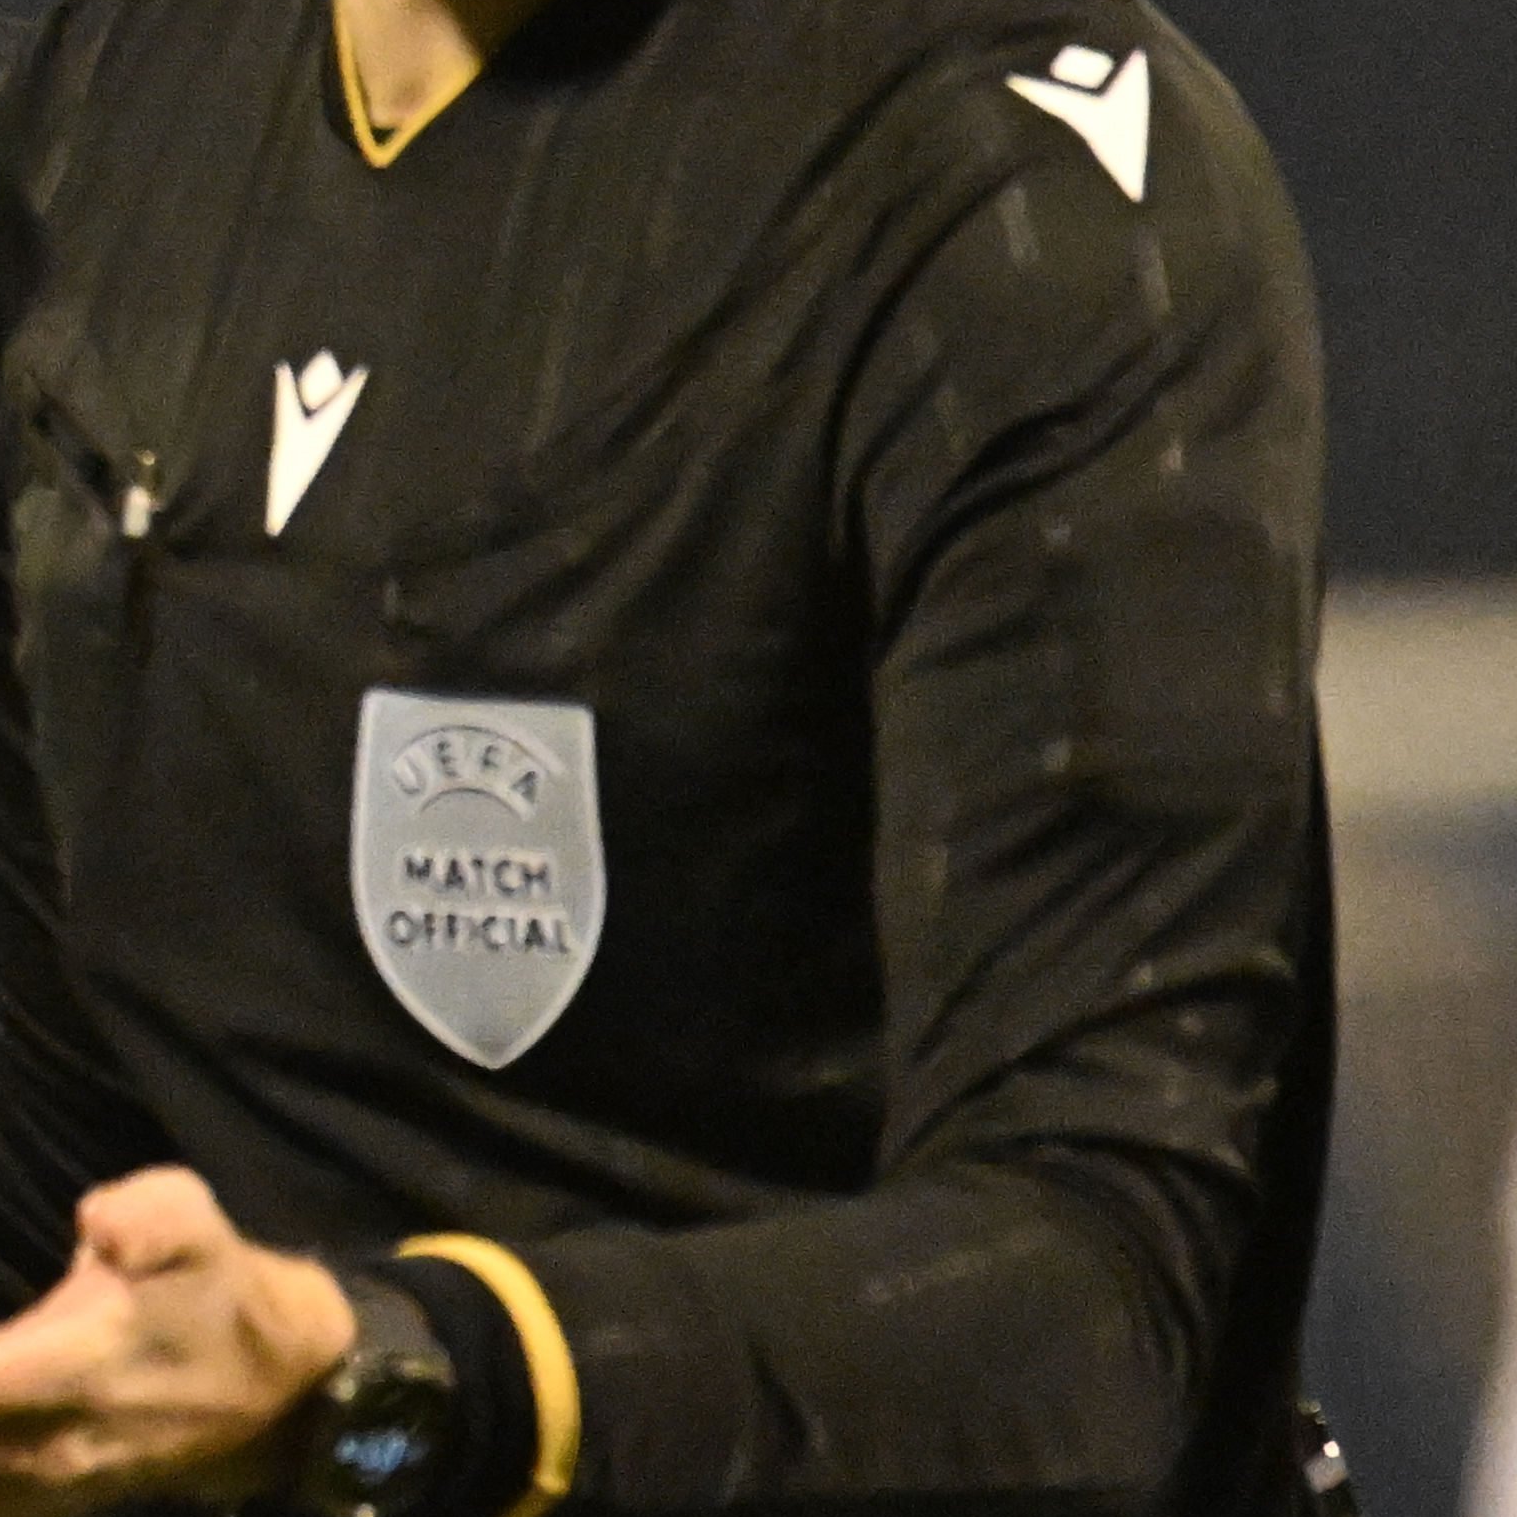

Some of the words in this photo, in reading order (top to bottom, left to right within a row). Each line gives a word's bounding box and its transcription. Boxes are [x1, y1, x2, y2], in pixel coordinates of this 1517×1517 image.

[391, 734, 542, 805] UEFA
[402, 853, 553, 897] MATCH
[385, 909, 571, 955] OFFICIAL
